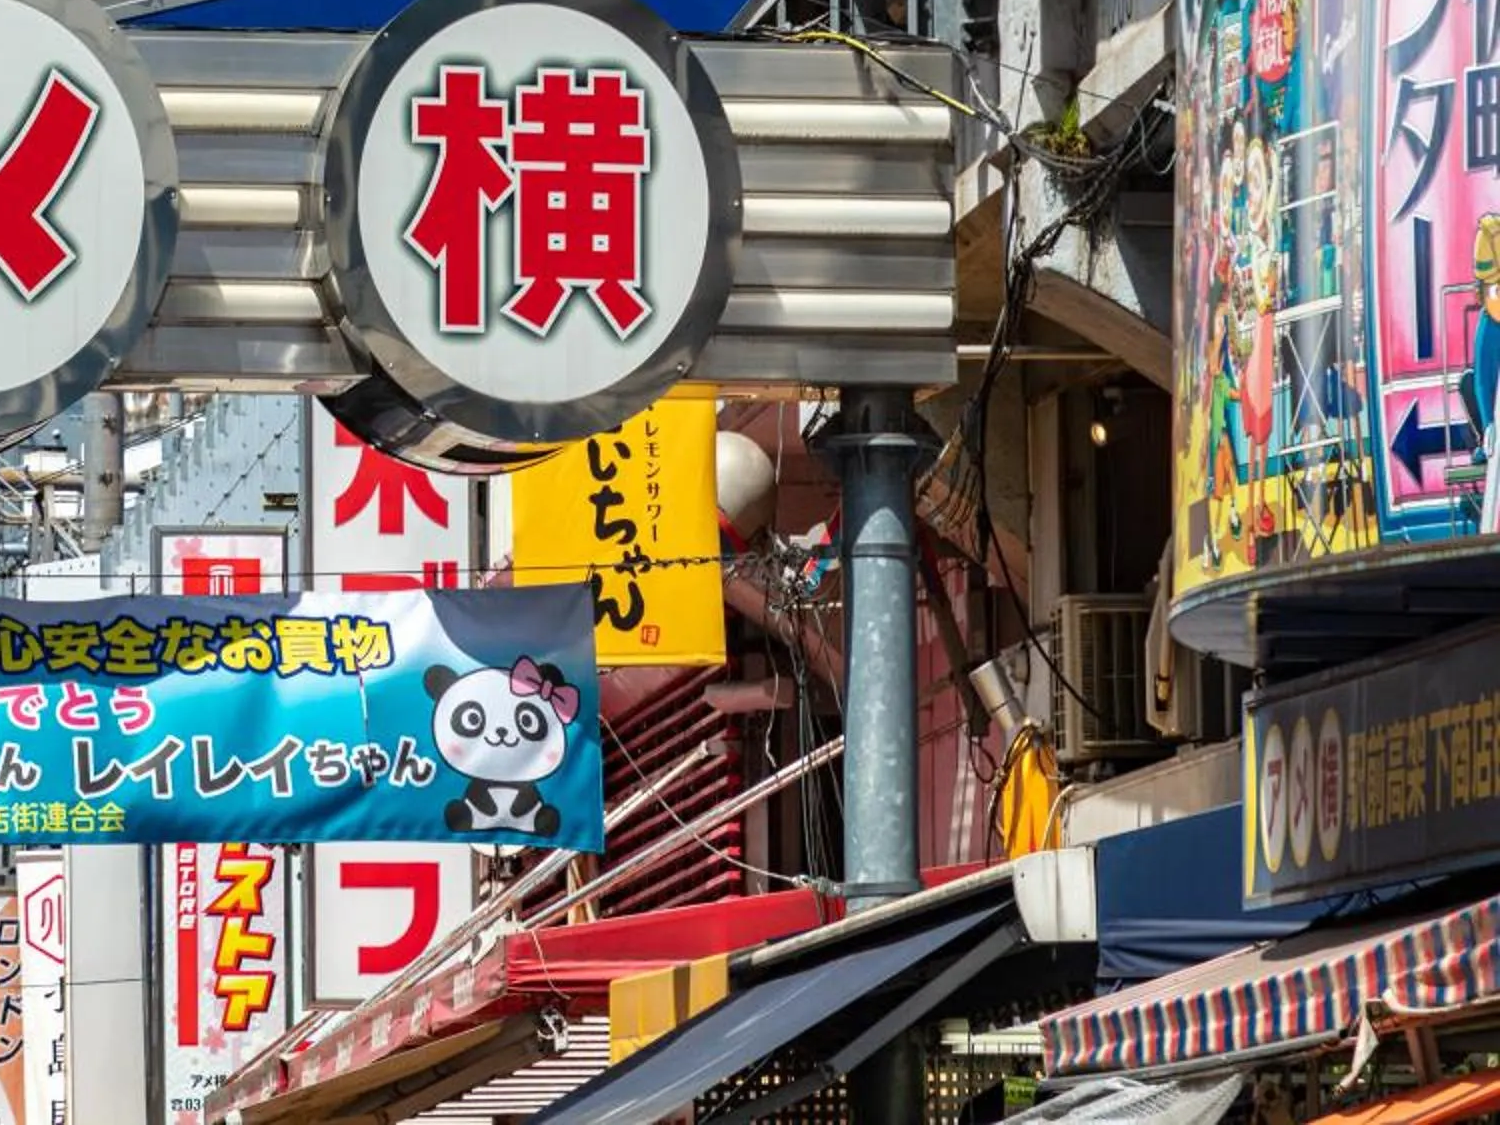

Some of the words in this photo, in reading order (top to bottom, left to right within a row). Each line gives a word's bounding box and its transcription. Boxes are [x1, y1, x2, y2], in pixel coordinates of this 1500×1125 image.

[587, 423, 651, 631] いちゃん
[72, 736, 435, 799] レイレイちゃん
[1347, 692, 1500, 832] 駅前高架下商店
[179, 848, 197, 930] STORE
[206, 843, 276, 1031] ストア
